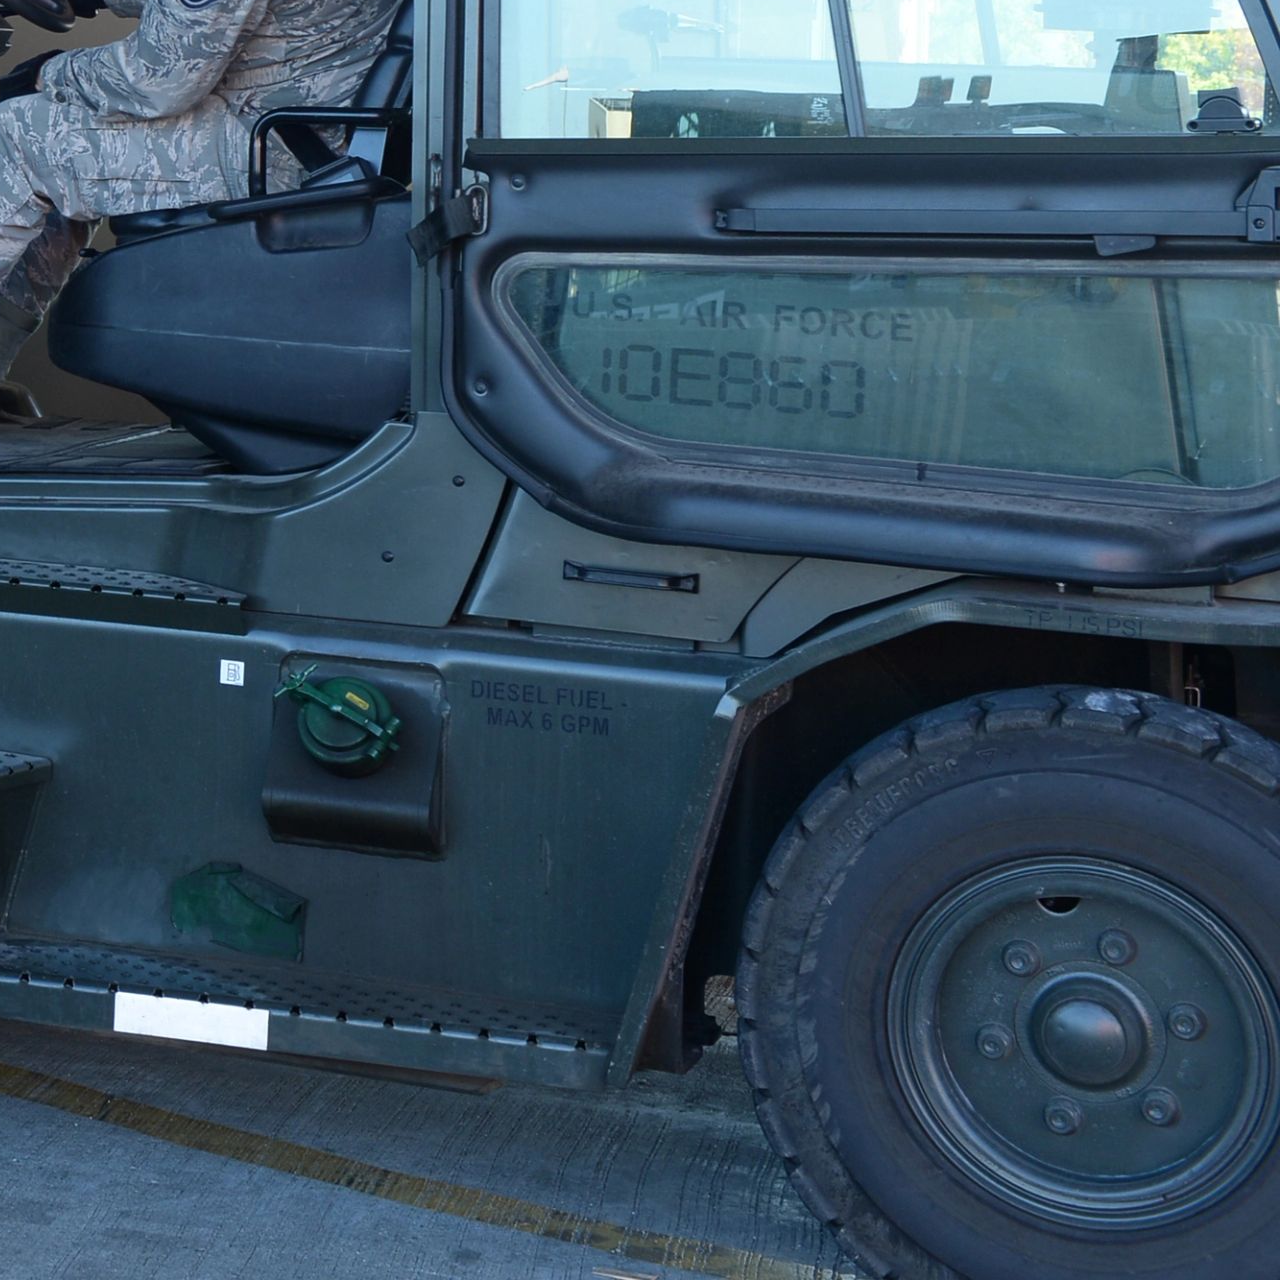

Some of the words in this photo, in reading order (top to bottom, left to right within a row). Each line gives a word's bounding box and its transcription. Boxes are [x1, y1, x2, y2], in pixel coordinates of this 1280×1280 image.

[680, 300, 747, 331] AIR
[773, 304, 914, 342] FORCE
[602, 344, 864, 419] 10E860
[471, 679, 549, 705] DIESEL
[556, 687, 613, 711] FUEL
[487, 707, 534, 730] MAX
[542, 712, 553, 732] 6
[561, 713, 610, 737] GPM
